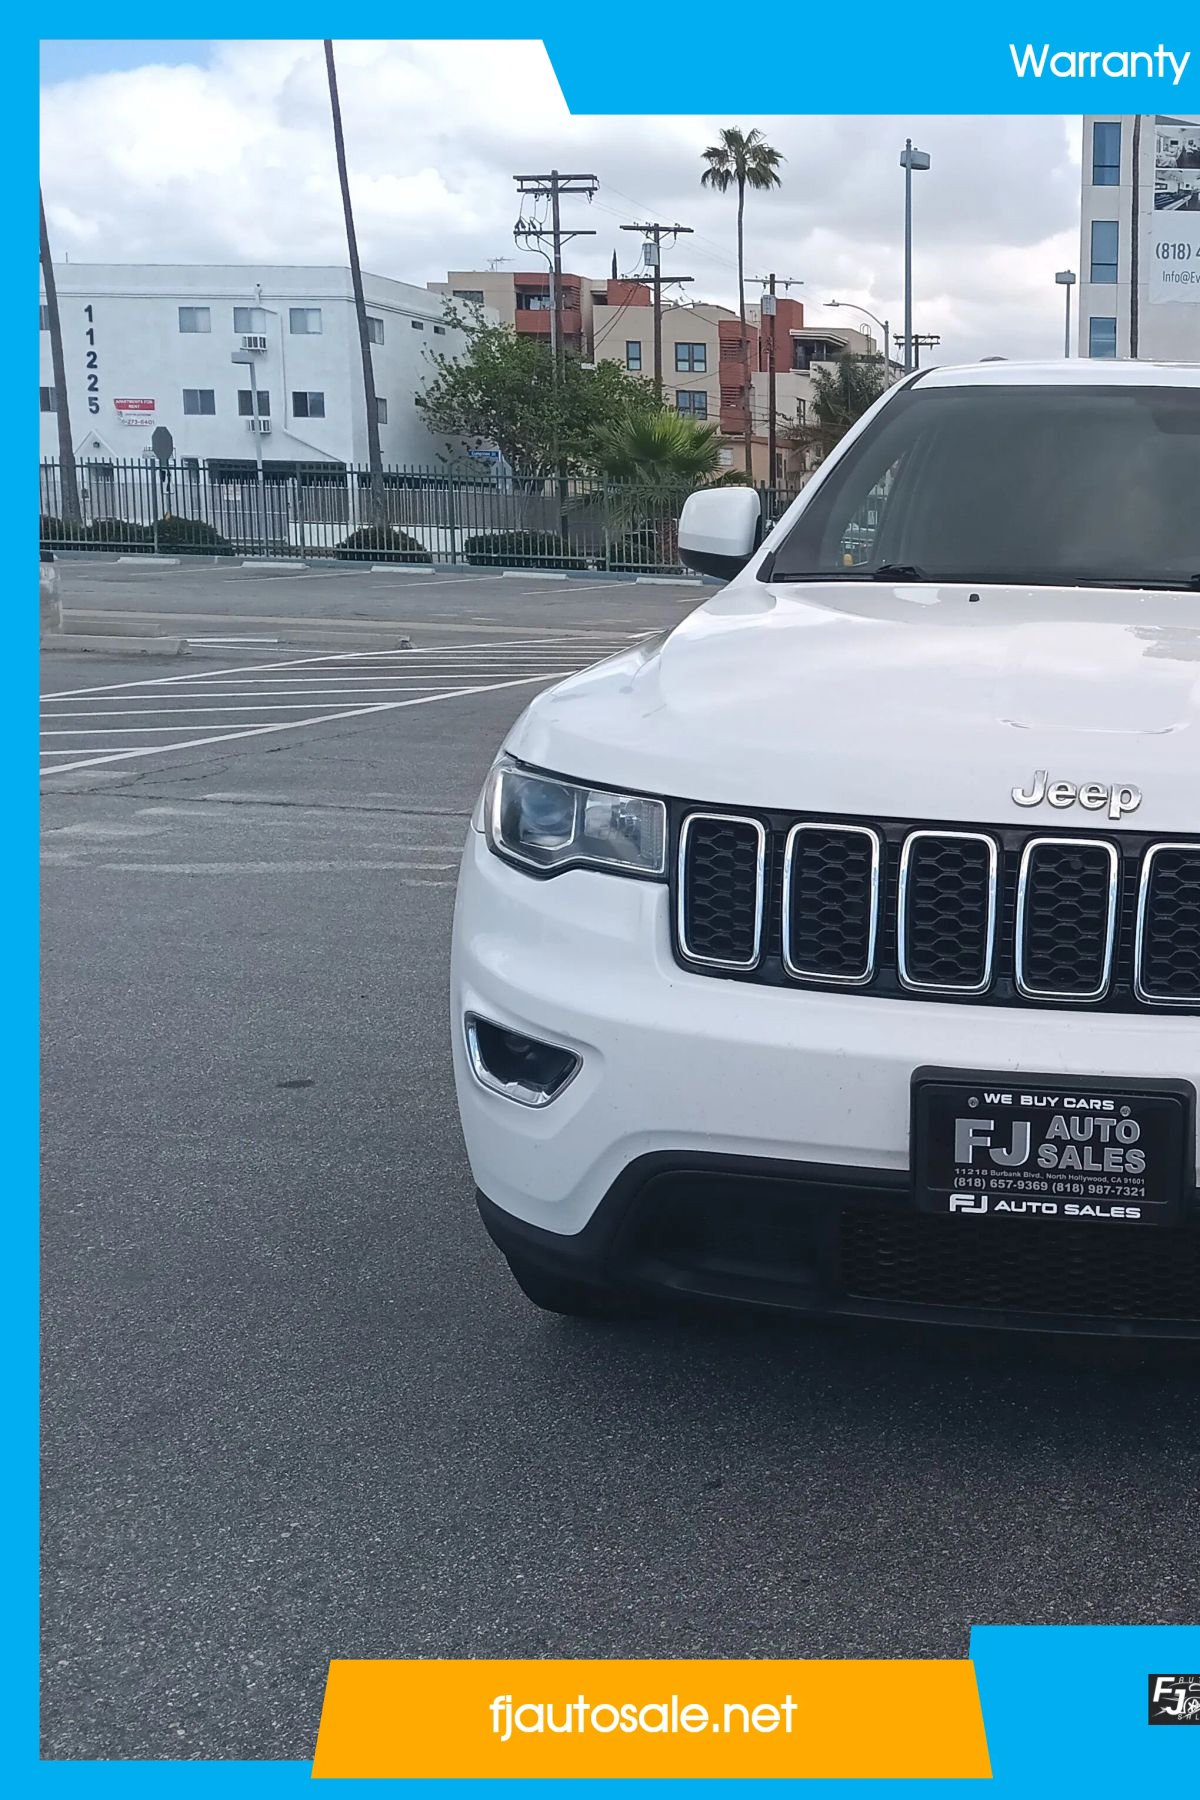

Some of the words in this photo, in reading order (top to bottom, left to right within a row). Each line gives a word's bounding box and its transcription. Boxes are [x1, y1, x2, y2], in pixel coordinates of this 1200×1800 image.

[1156, 243, 1191, 260] (818)
[84, 304, 100, 415] 11225
[1011, 769, 1143, 820] Jeep
[984, 1092, 1013, 1105] WE
[1020, 1095, 1060, 1108] BUY
[1063, 1097, 1115, 1111] CARS
[954, 1118, 1031, 1167] FJ
[1045, 1114, 1141, 1144] AUTO
[1037, 1143, 1146, 1174] SALES
[954, 1168, 988, 1176] 11218
[990, 1169, 1022, 1178] Burbank
[1046, 1172, 1067, 1180] North
[1068, 1174, 1109, 1183] Hollywood,
[1111, 1176, 1122, 1184] CA
[954, 1177, 986, 1190] (818)
[990, 1178, 1048, 1191] 657-9369
[1052, 1181, 1084, 1195] (818)
[1088, 1184, 1145, 1197] 987-7321
[950, 1193, 988, 1214] FJ
[994, 1200, 1058, 1215] AUTO
[1064, 1203, 1142, 1219] SALES
